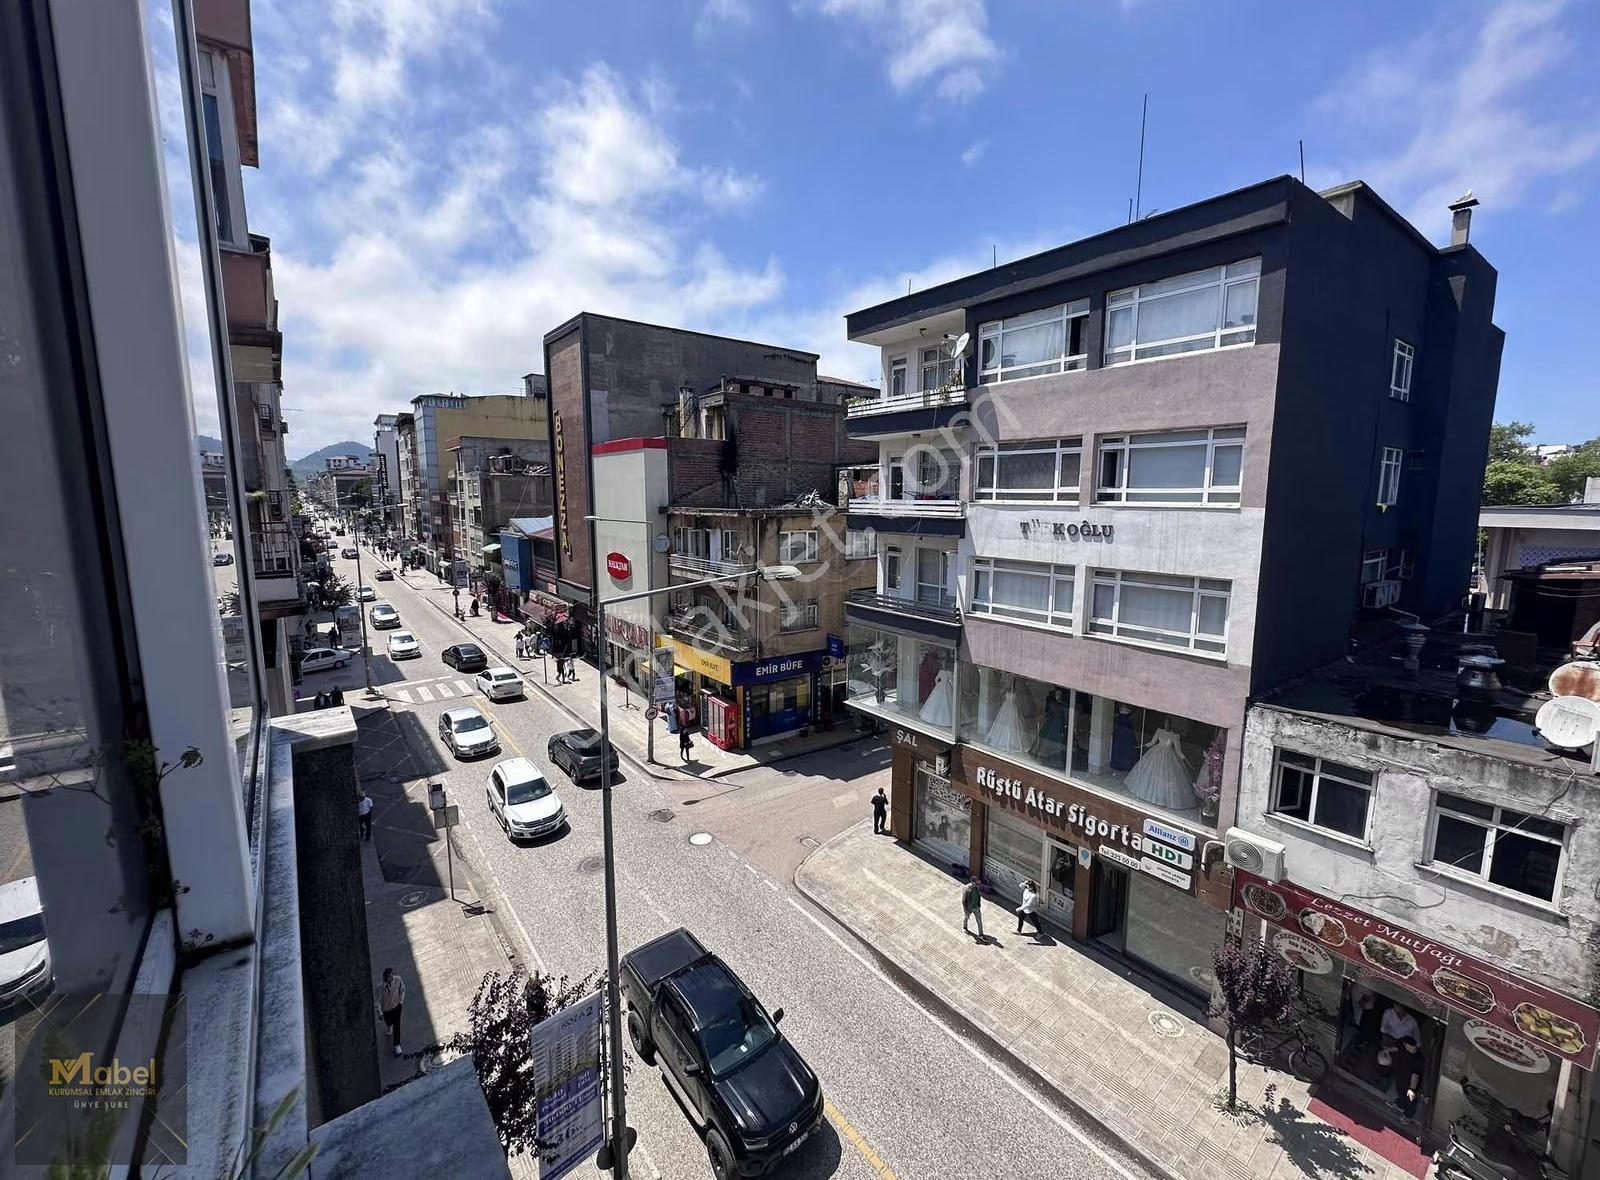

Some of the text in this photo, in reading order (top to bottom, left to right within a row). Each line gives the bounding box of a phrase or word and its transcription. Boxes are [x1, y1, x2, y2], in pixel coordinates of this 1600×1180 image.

[554, 416, 569, 551] BONEZZA
[756, 660, 803, 676] EMİR BÜFE
[976, 766, 1143, 851] Rüştü Atar Sigorta
[1149, 825, 1178, 842] Allianz
[1151, 843, 1183, 865] HDI
[1311, 897, 1464, 967] Lezzet Mutfağı
